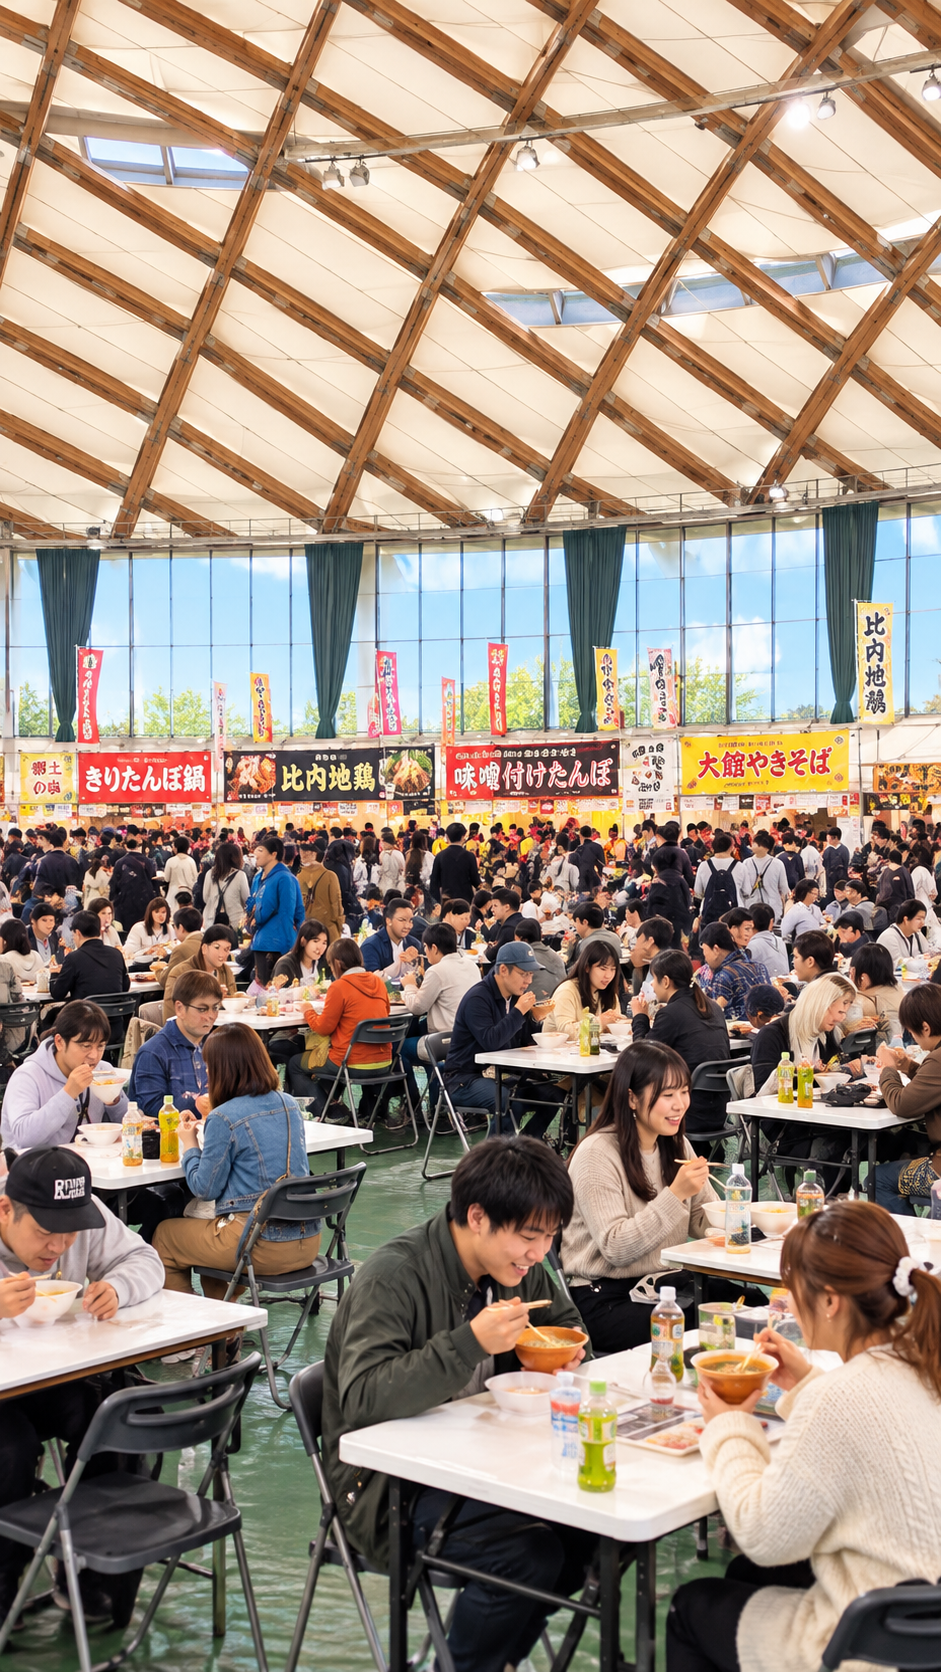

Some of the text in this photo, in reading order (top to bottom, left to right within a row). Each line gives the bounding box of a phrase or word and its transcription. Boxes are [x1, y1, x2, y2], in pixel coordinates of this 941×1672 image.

[280, 762, 376, 793] 比内地鶏
[697, 746, 833, 779] 大館やきそば
